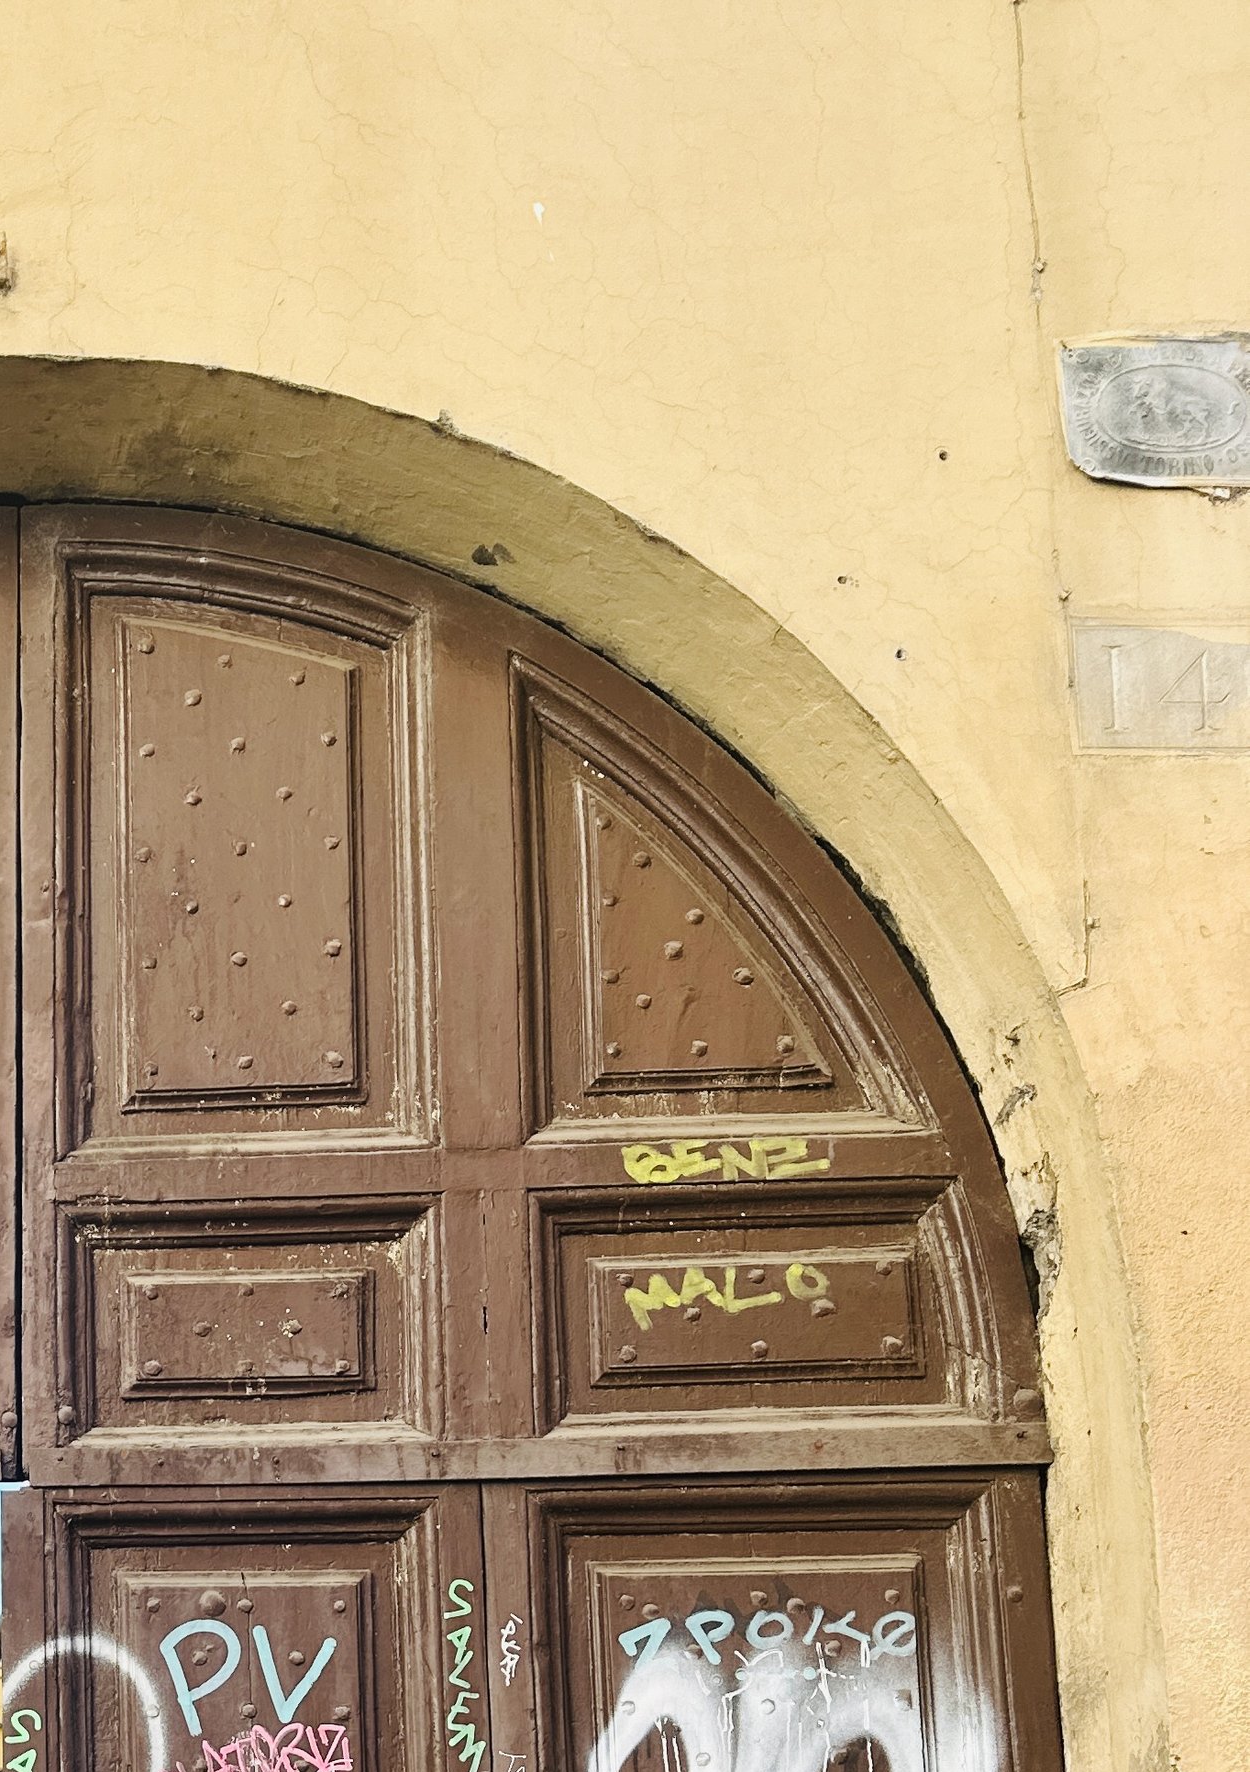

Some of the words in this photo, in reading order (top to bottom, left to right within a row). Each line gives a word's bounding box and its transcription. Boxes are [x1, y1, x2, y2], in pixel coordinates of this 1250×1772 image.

[620, 1137, 831, 1185] BENZ
[623, 1262, 831, 1331] MALO
[158, 1618, 338, 1737] PV
